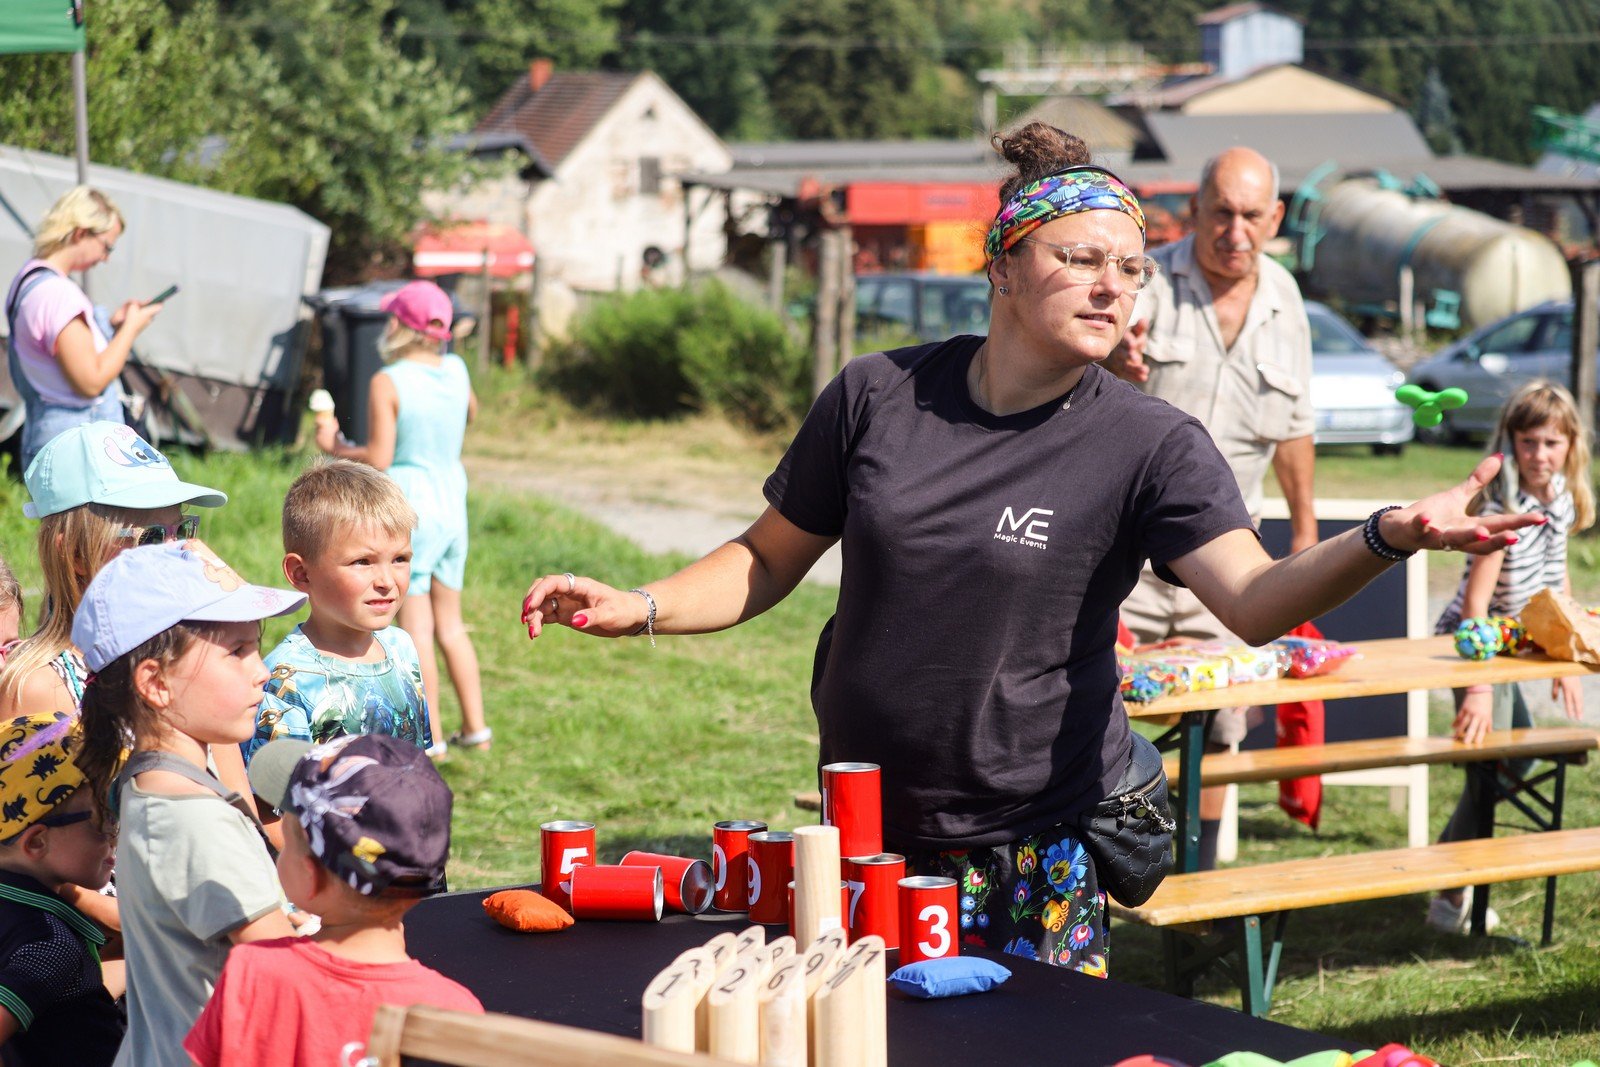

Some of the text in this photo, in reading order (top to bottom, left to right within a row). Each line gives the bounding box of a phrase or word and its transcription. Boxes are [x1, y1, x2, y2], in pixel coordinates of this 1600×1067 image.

[996, 506, 1054, 541] ME
[993, 533, 1047, 550] Magic Events
[559, 847, 589, 895] 5
[748, 857, 761, 906] 9
[848, 880, 865, 928] 7
[918, 905, 951, 958] 3
[767, 964, 795, 990] 6
[805, 952, 824, 976] 9
[656, 972, 682, 997] 1
[719, 968, 746, 993] 2
